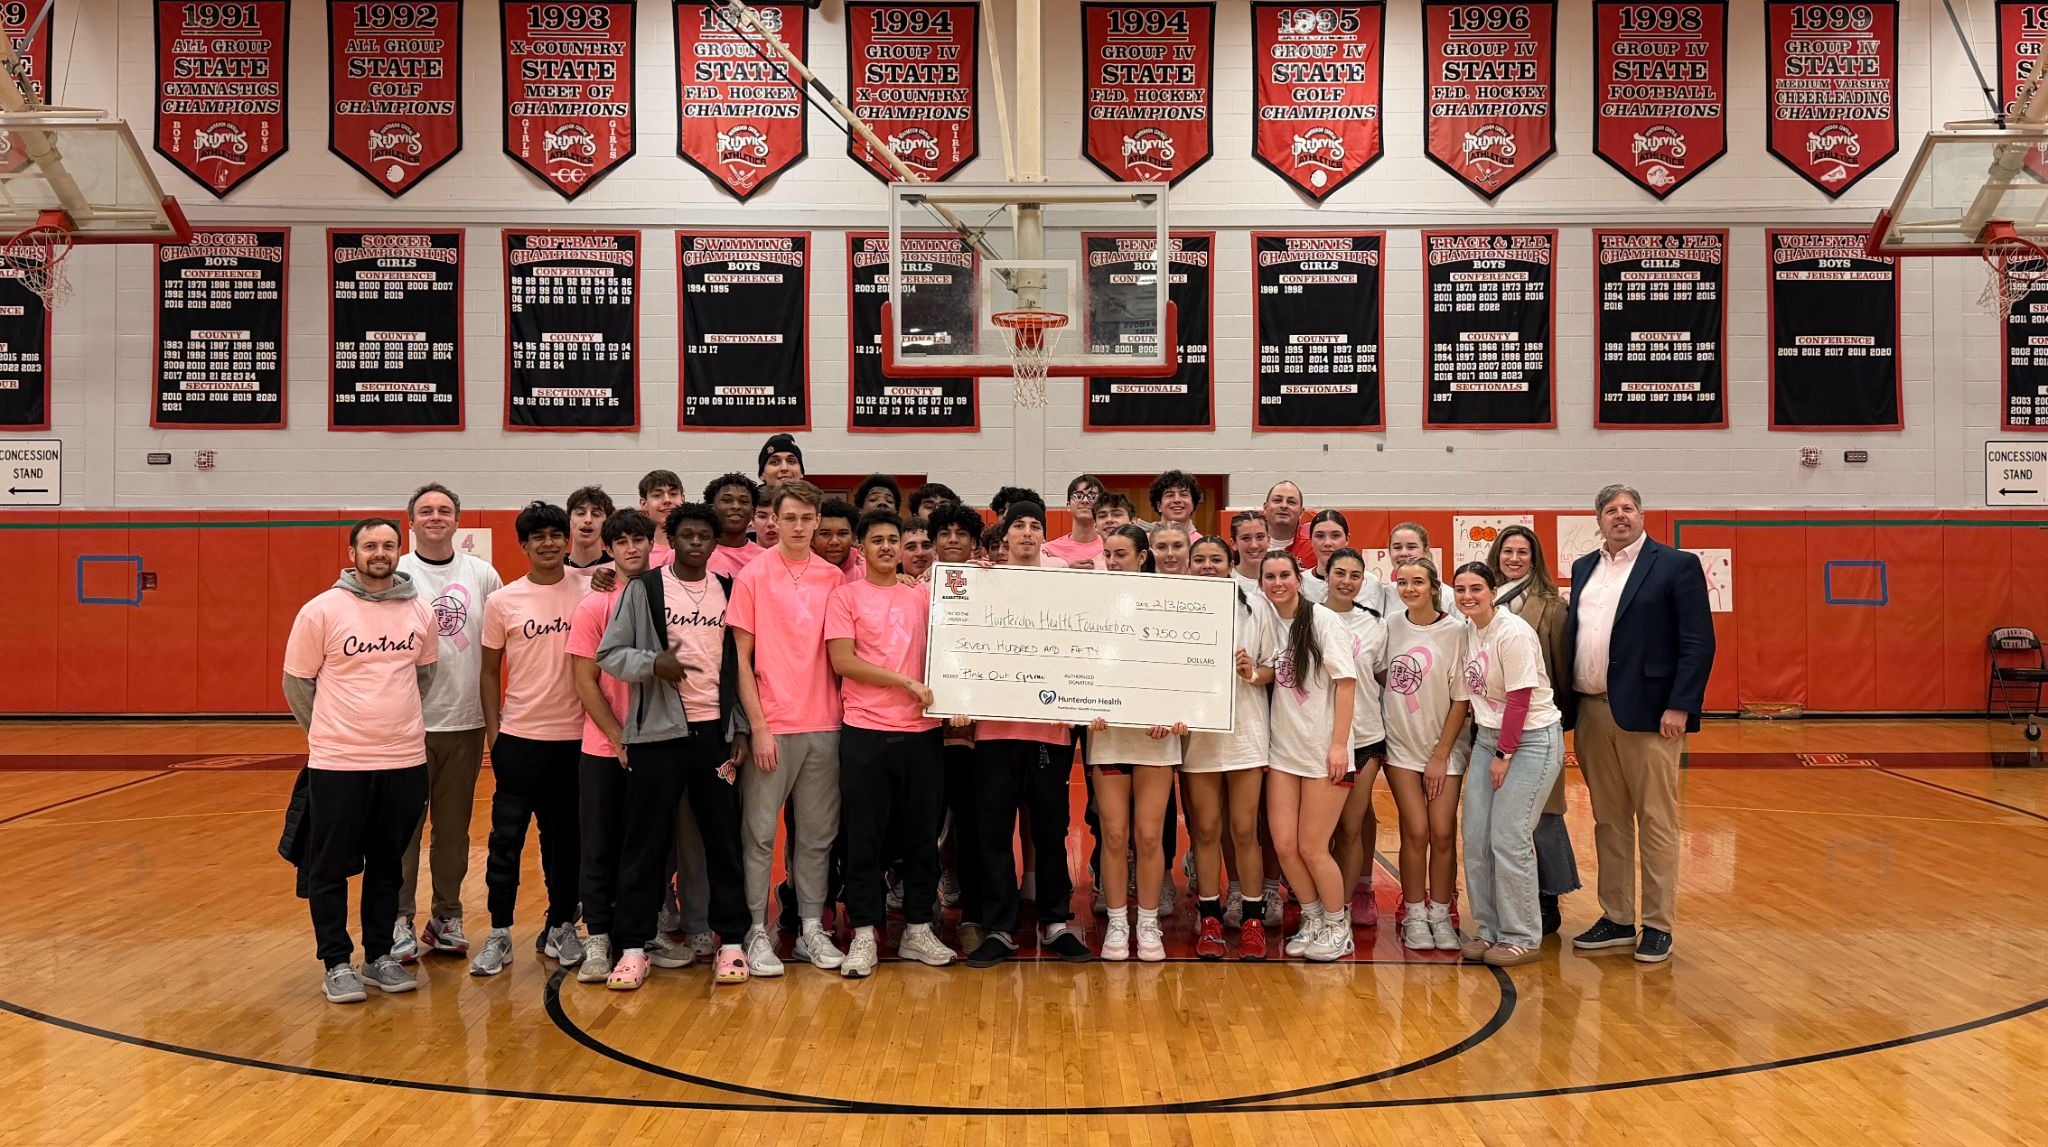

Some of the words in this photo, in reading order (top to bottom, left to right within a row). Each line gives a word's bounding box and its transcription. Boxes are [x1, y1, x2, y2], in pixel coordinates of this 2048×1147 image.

[182, 4, 259, 28] 1991
[354, 4, 437, 28] 1992
[527, 5, 611, 30] 1993
[871, 9, 953, 34] 1994
[1107, 9, 1189, 35] 1994
[1277, 8, 1360, 34] 1995
[1448, 6, 1530, 31] 1996
[1619, 6, 1703, 31] 1998
[1791, 6, 1874, 31] 1999
[172, 39, 207, 53] ALL
[211, 39, 272, 53] GROUP
[345, 39, 380, 53] ALL
[384, 39, 444, 53] GROUP
[511, 41, 626, 56] X-COUNTRY
[865, 45, 933, 60] GROUP
[937, 45, 960, 60] IV
[1100, 45, 1169, 60] GROUP
[1172, 45, 1196, 60] IV
[1271, 43, 1338, 58] GROUP
[1343, 43, 1366, 58] IV
[1441, 42, 1509, 57] GROUP
[1514, 42, 1538, 57] IV
[1612, 41, 1681, 57] GROUP
[1685, 41, 1710, 57] IV
[1784, 40, 1851, 56] GROUP
[1856, 40, 1880, 56] IV
[174, 57, 269, 78] STATE
[347, 58, 443, 79] STATE
[521, 60, 615, 81] STATE
[695, 62, 789, 82] STATE
[1272, 62, 1366, 83] STATE
[1442, 61, 1537, 82] STATE
[1613, 60, 1709, 81] STATE
[1785, 55, 1880, 76] STATE
[865, 64, 960, 84] STATE
[1101, 64, 1195, 85] STATE
[163, 82, 279, 96] GYMNASTICS
[368, 82, 422, 97] GOLF
[1776, 79, 1831, 89] MEDIUM
[1833, 79, 1890, 89] VARSITY
[524, 85, 582, 100] MEET
[586, 85, 614, 100] OF
[684, 86, 722, 101] FLD.
[729, 86, 799, 101] HOCKEY
[856, 87, 969, 103] X-COUNTRY
[1091, 88, 1129, 103] FLD.
[1135, 88, 1205, 103] HOCKEY
[1292, 88, 1345, 103] GOLF
[1432, 85, 1471, 100] FLD.
[1476, 85, 1547, 100] HOCKEY
[1608, 85, 1716, 100] FOOTBALL
[1775, 90, 1891, 105] CHEERLEADING
[161, 100, 280, 115] CHAMPIONS
[335, 101, 455, 115] CHAMPIONS
[510, 103, 628, 117] CHAMPIONS
[684, 103, 800, 118] CHAMPIONS
[855, 106, 970, 121] CHAMPIONS
[1089, 105, 1206, 121] CHAMPIONS
[1260, 105, 1377, 121] CHAMPIONS
[1430, 103, 1547, 118] CHAMPIONS
[1600, 103, 1720, 118] CHAMPIONS
[1776, 105, 1891, 120] CHAMPIONS
[172, 121, 181, 153] BOYS
[260, 121, 269, 153] BOYS
[191, 233, 258, 246] SOCCER
[361, 235, 432, 248] SOCCER
[526, 236, 618, 249] SOFTBALL
[694, 238, 792, 250] SWIMMING
[1286, 238, 1353, 250] TENNIS
[1431, 237, 1491, 249] TRACK
[1493, 237, 1508, 249] &
[1511, 236, 1551, 248] FLD.
[1602, 235, 1662, 248] TRACK
[1665, 236, 1679, 248] &
[1683, 235, 1722, 248] FLD.
[161, 247, 282, 262] CHAMPIONSHIPS
[204, 257, 238, 266] BOYS
[335, 248, 457, 264] CHAMPIONSHIPS
[511, 250, 634, 266] CHAMPIONSHIPS
[684, 251, 803, 267] CHAMPIONSHIPS
[1259, 250, 1378, 266] CHAMPIONSHIPS
[1429, 249, 1550, 265] CHAMPIONSHIPS
[1600, 249, 1721, 264] CHAMPIONSHIPS
[377, 258, 417, 268] GIRLS
[727, 262, 760, 271] BOYS
[1300, 262, 1339, 270] GIRLS
[1473, 260, 1505, 269] BOYS
[1641, 259, 1681, 268] GIRLS
[1818, 259, 1851, 268] BOYS
[183, 270, 259, 278] CONFERENCE
[358, 272, 434, 280] CONFERENCE
[535, 268, 612, 276] CONFERENCE
[1282, 275, 1355, 283] CONFERENCE
[1452, 272, 1527, 280] CONFERENCE
[1806, 272, 1845, 280] JERSEY
[1850, 272, 1890, 280] LEAGUE
[1433, 283, 1452, 291] 1970
[1456, 283, 1473, 292] 1971
[1479, 283, 1498, 291] 1972
[1525, 282, 1544, 291] 1977
[710, 335, 777, 343] SECTIONALS
[1467, 333, 1511, 341] COUNTY
[1798, 337, 1872, 345] CONFERENCE
[1824, 348, 1844, 356] 2017
[1869, 348, 1892, 356] 2020
[186, 382, 254, 390] SECTIONALS
[361, 384, 430, 392] SECTIONALS
[537, 389, 607, 397] SECTIONALS
[722, 387, 767, 395] COUNTY
[1285, 385, 1352, 393] SECTIONALS
[1627, 383, 1695, 391] SECTIONALS
[1988, 451, 2047, 462] CONCESSION
[13, 468, 44, 479] STAND
[2003, 469, 2033, 480] STAND
[1152, 599, 1207, 612] 2/3/2026
[984, 605, 1035, 628] Hunterdon
[1040, 609, 1072, 630] Health
[1075, 611, 1135, 633] Foundation
[523, 616, 572, 639] Centr
[343, 632, 415, 657] Central
[1186, 656, 1215, 665] DOLLARS
[988, 670, 1009, 680] Out
[1058, 695, 1097, 704] Hunterdon
[1098, 698, 1122, 706] Health
